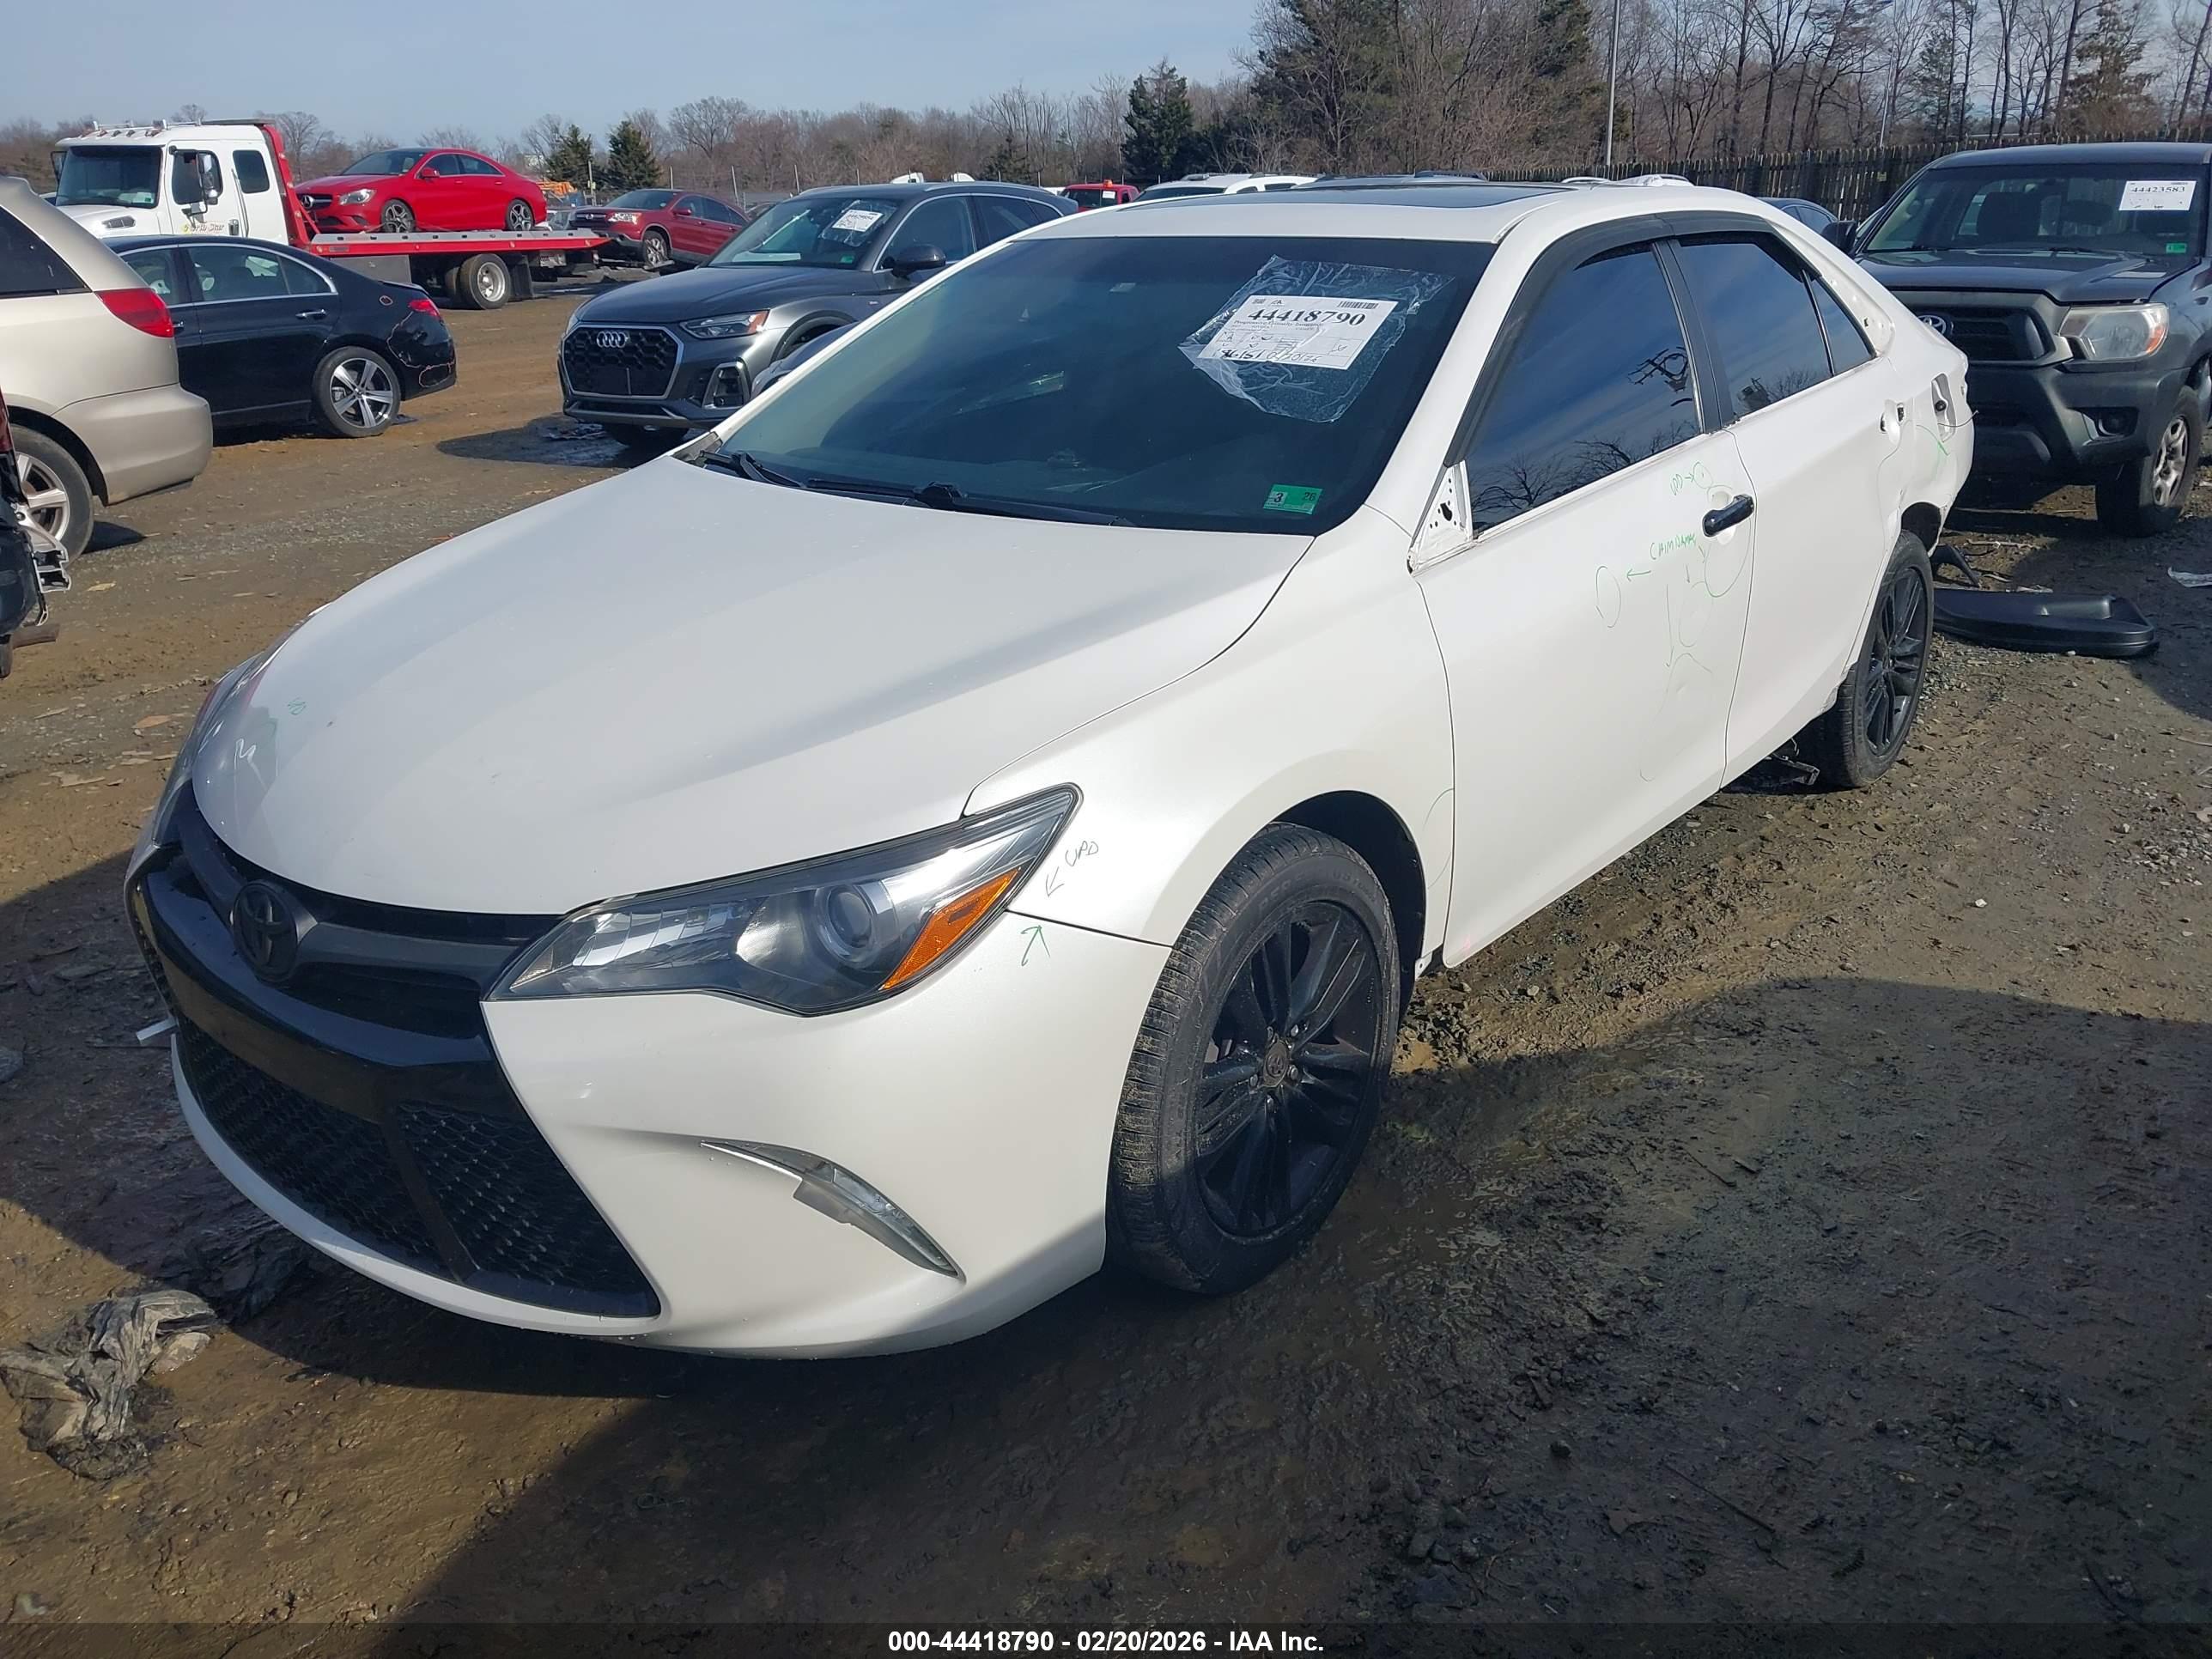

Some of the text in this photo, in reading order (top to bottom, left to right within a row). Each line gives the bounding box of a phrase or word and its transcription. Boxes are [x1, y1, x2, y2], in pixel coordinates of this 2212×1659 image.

[1248, 308, 1365, 325] 44418790
[1273, 492, 1284, 502] 3
[1065, 840, 1099, 866] UPD
